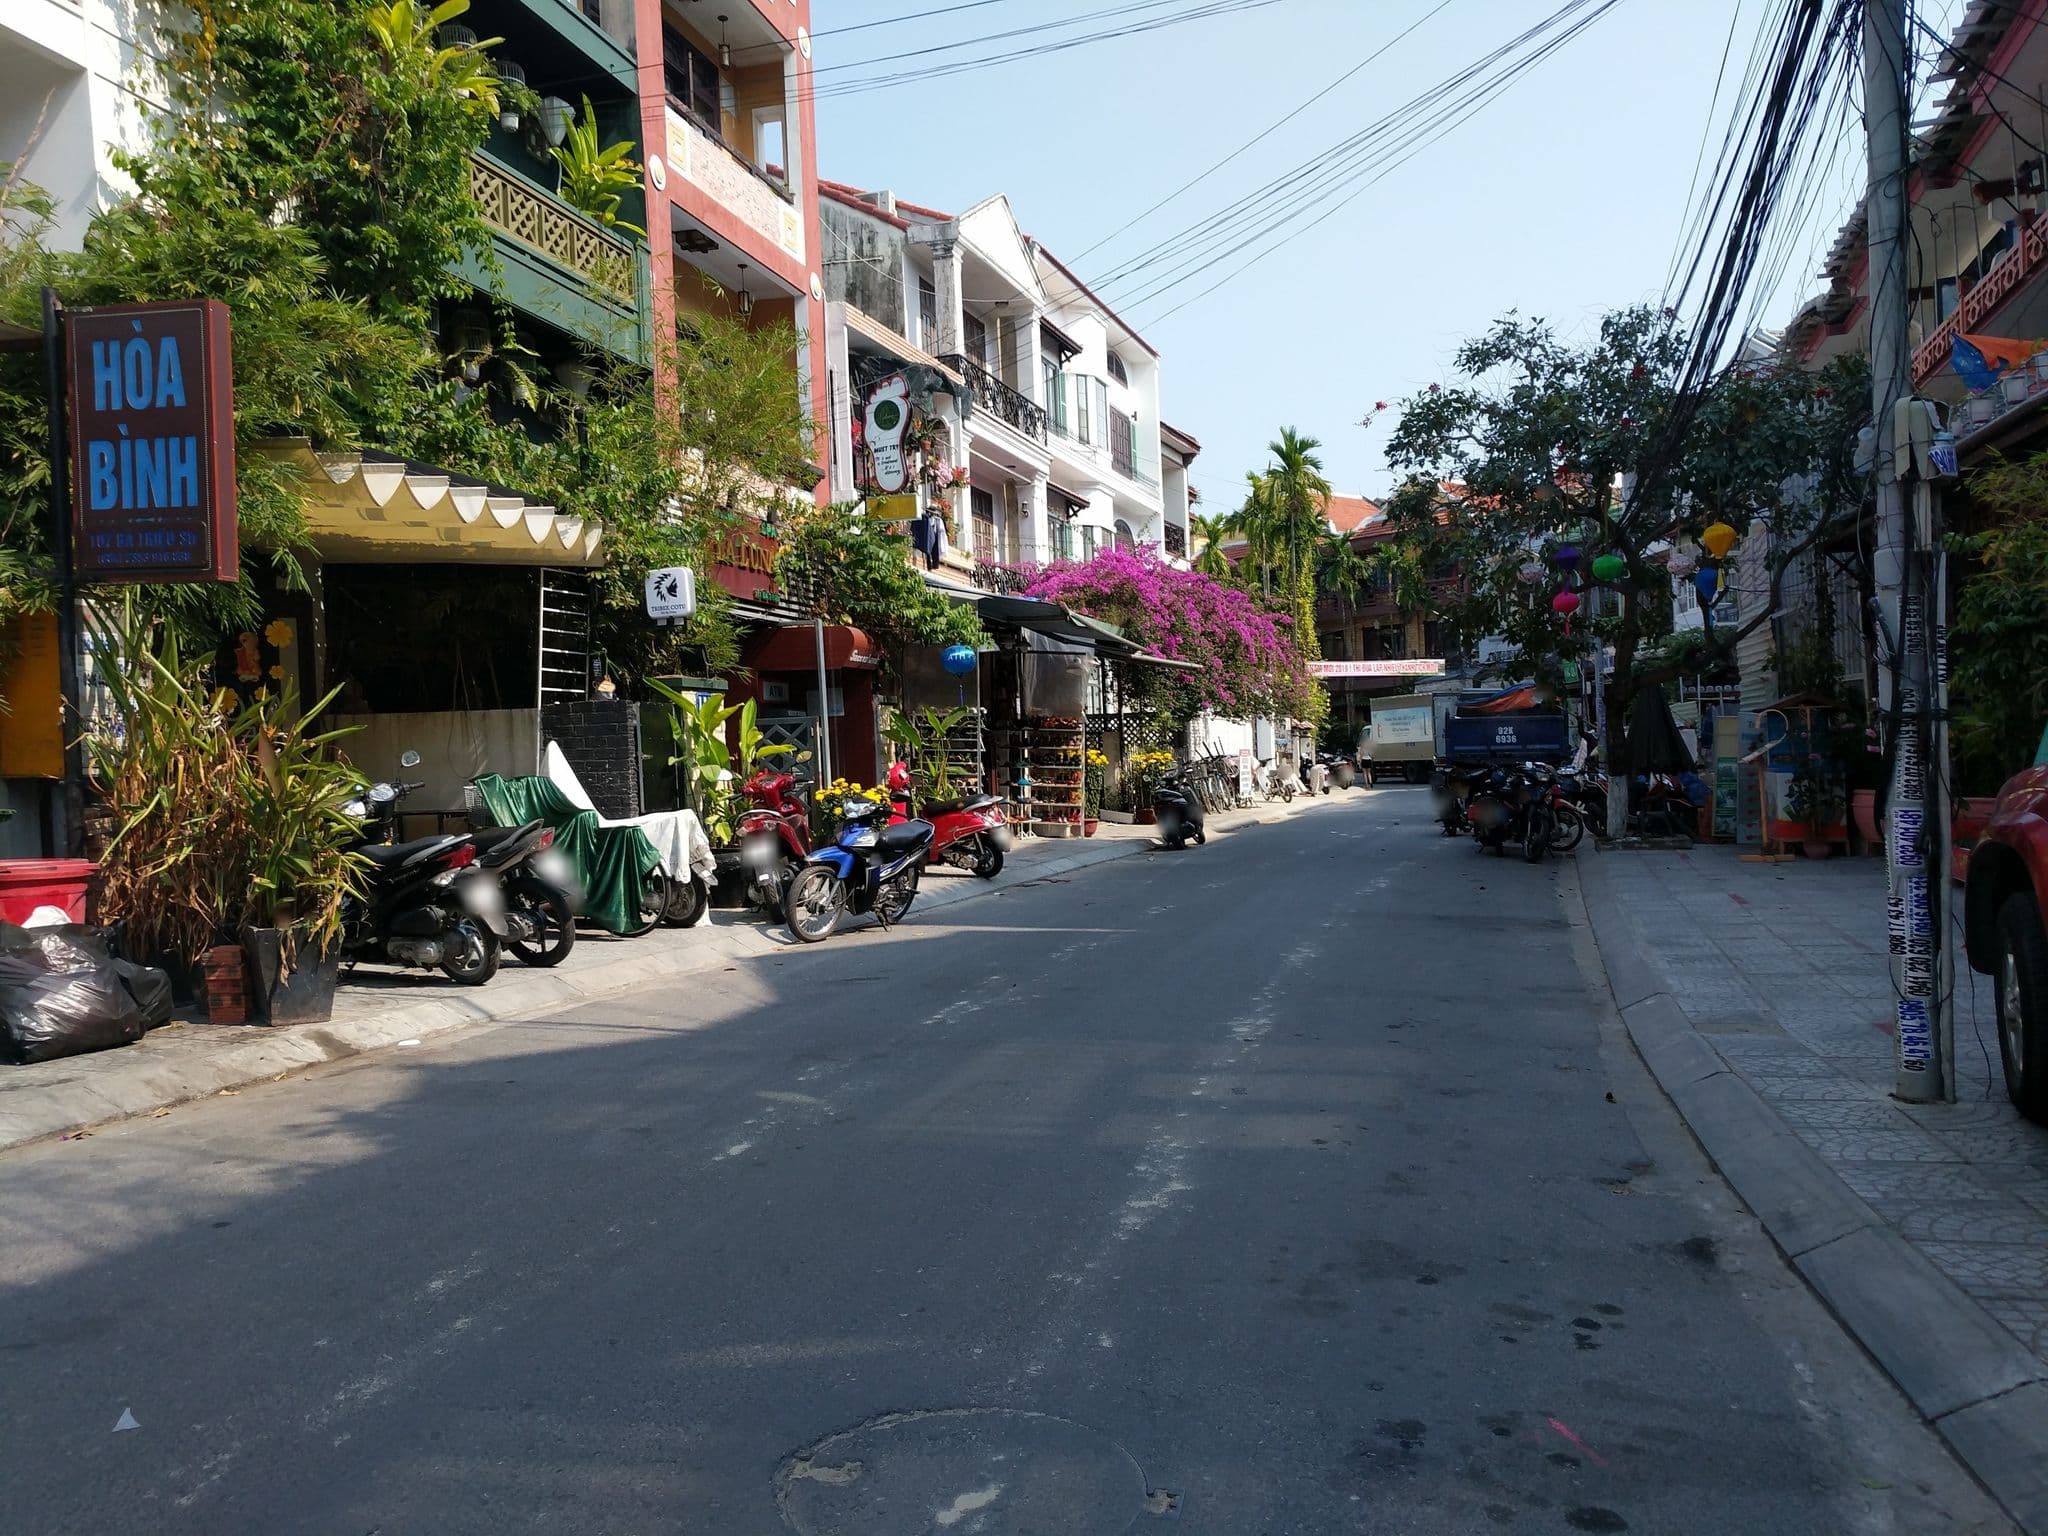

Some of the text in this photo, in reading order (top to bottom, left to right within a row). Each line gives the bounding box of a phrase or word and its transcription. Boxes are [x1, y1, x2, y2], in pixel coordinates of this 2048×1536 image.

[92, 319, 187, 411] HÒA
[88, 423, 199, 510] BÌNH
[1907, 939, 1932, 955] 630
[1907, 957, 1931, 973] 230
